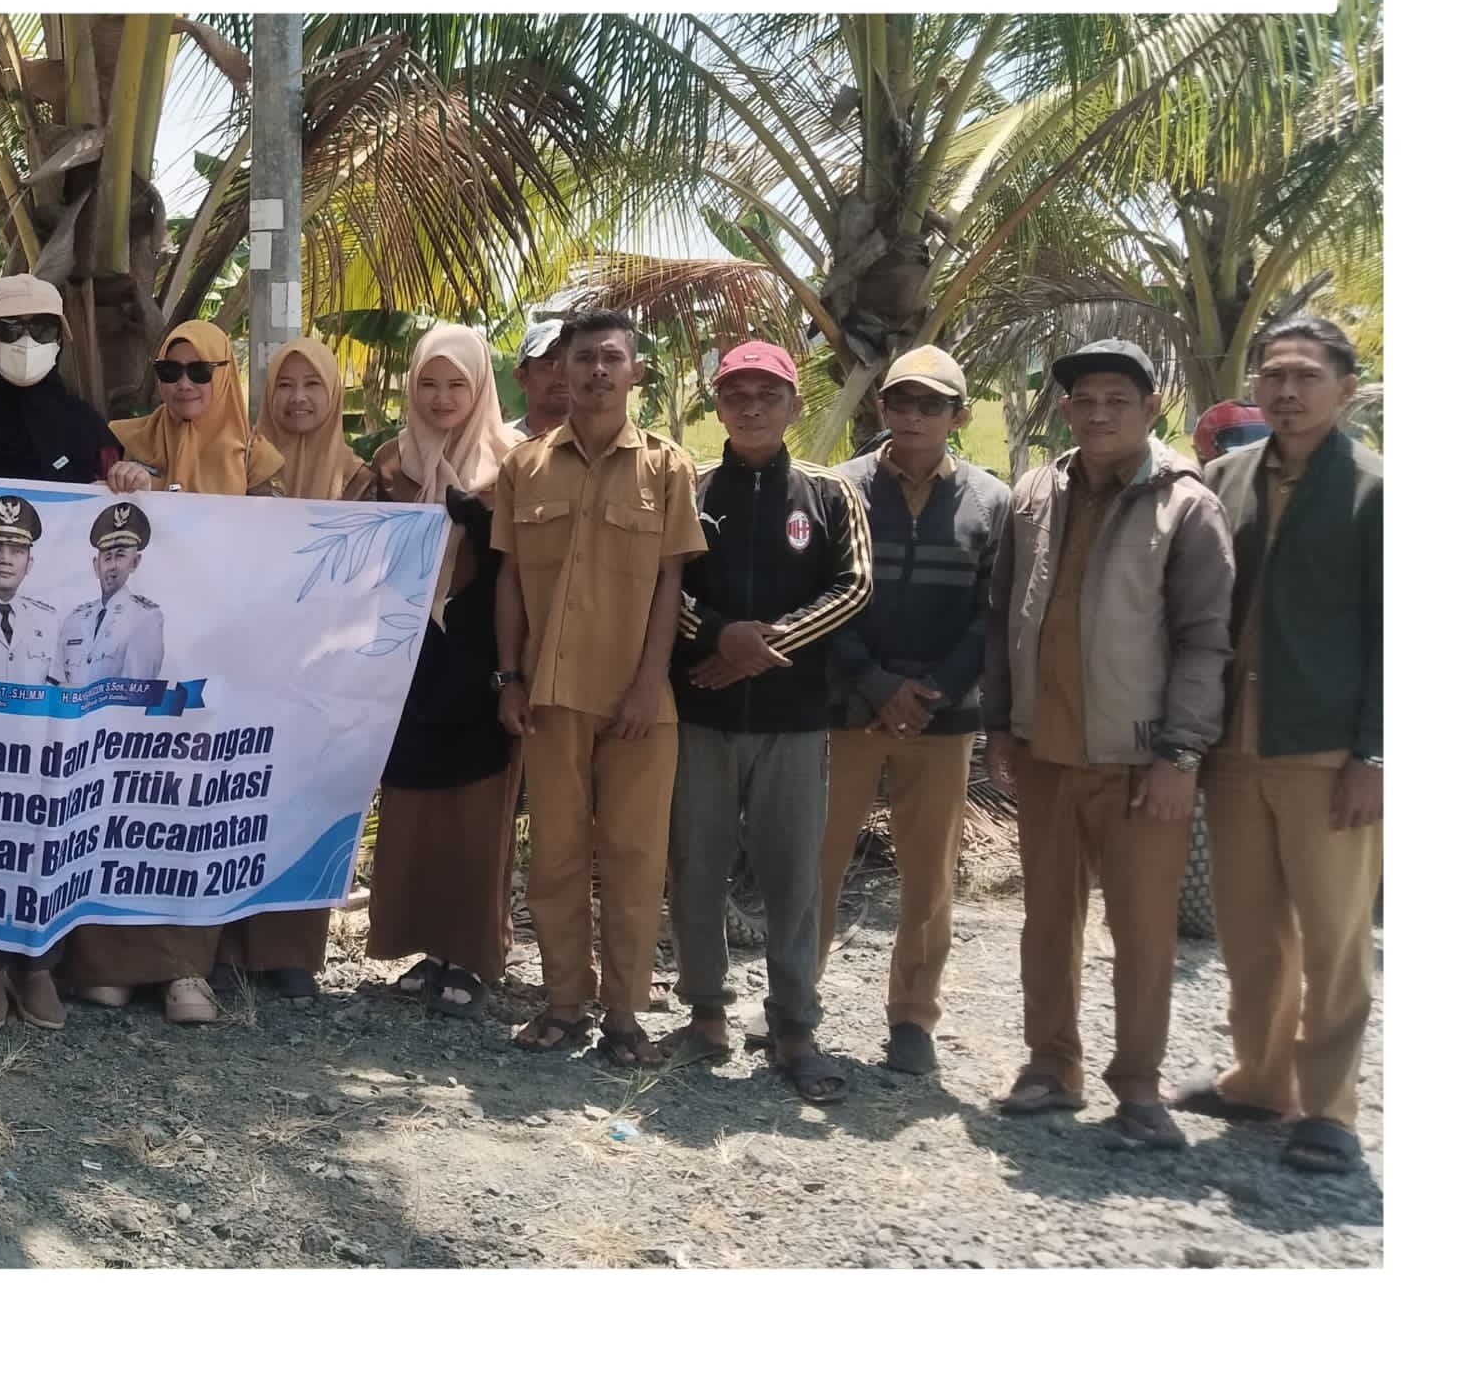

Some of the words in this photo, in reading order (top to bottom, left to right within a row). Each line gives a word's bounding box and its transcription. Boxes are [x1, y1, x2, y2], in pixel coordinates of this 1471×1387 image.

[40, 739, 89, 778] dan
[91, 726, 274, 765] Pemasangan
[112, 770, 182, 806] Titik
[188, 765, 273, 808] Lokasi
[41, 824, 100, 877] Batas
[103, 814, 268, 853] Kecamatan
[15, 868, 93, 926] Bumbu
[100, 860, 198, 898] Tahun
[203, 853, 266, 897] 2026
